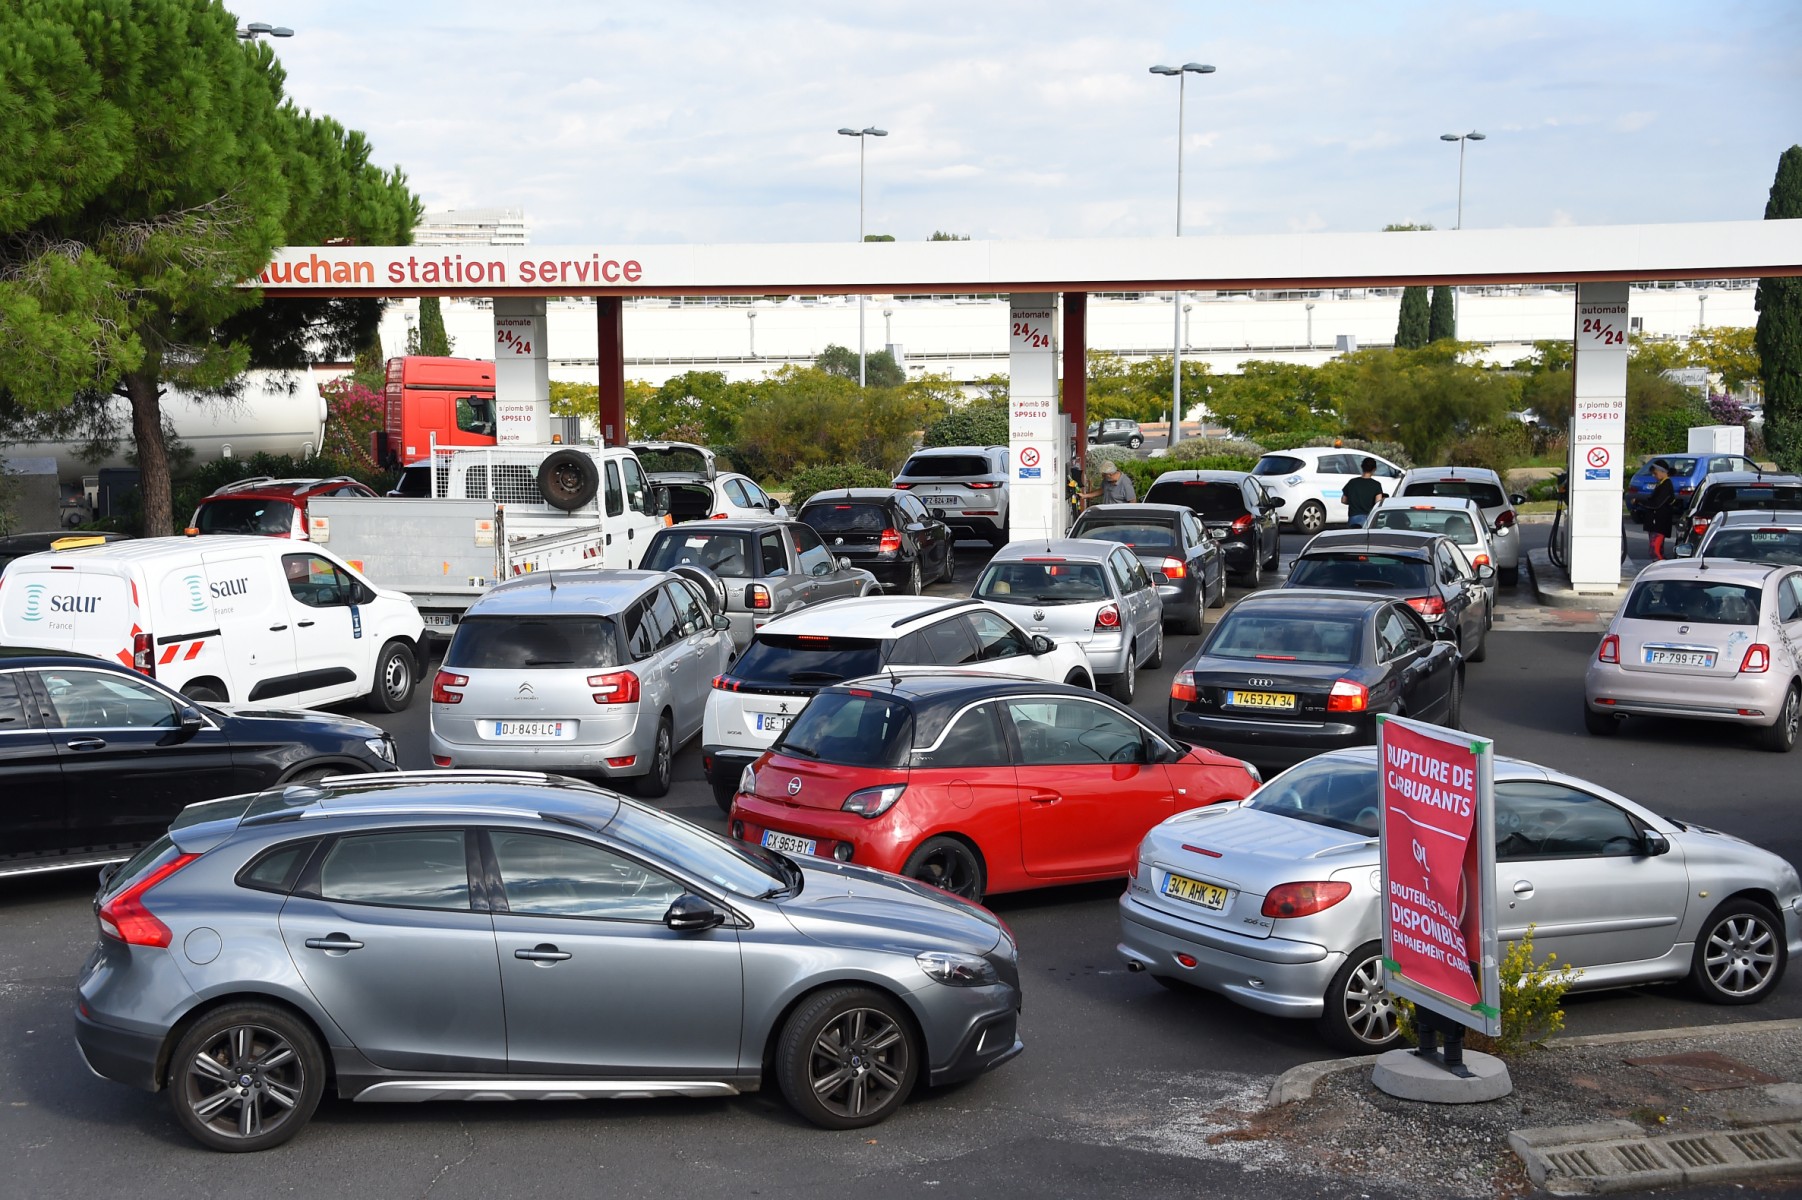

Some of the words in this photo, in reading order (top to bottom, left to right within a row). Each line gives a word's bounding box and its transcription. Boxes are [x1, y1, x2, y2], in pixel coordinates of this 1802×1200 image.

[388, 254, 506, 283] station
[519, 253, 642, 283] service
[1012, 311, 1050, 319] automate
[1581, 306, 1627, 315] automate
[1013, 323, 1049, 348] 24/24
[1583, 319, 1624, 345] 24/24
[497, 330, 531, 354] 24/24
[1578, 401, 1610, 410] s/plomb
[1582, 412, 1619, 420] SP95E10
[1012, 431, 1034, 439] gazole
[1577, 433, 1602, 442] gazole
[209, 577, 249, 598] saur
[50, 594, 102, 613] saur
[214, 607, 235, 616] France
[48, 621, 73, 630] France
[1653, 652, 1704, 664] FP-799-FZ
[1237, 692, 1264, 705] 7463
[1265, 694, 1278, 706] ZY
[1279, 695, 1293, 707] 34
[502, 723, 554, 736] DJ-849-LC
[1387, 743, 1450, 784] RUPTURE
[1452, 765, 1473, 791] DE
[766, 833, 810, 853] CX-963-BY
[1168, 877, 1188, 894] 347
[1189, 882, 1208, 902] AHK
[1208, 890, 1224, 907] 34
[1393, 929, 1404, 946] EN
